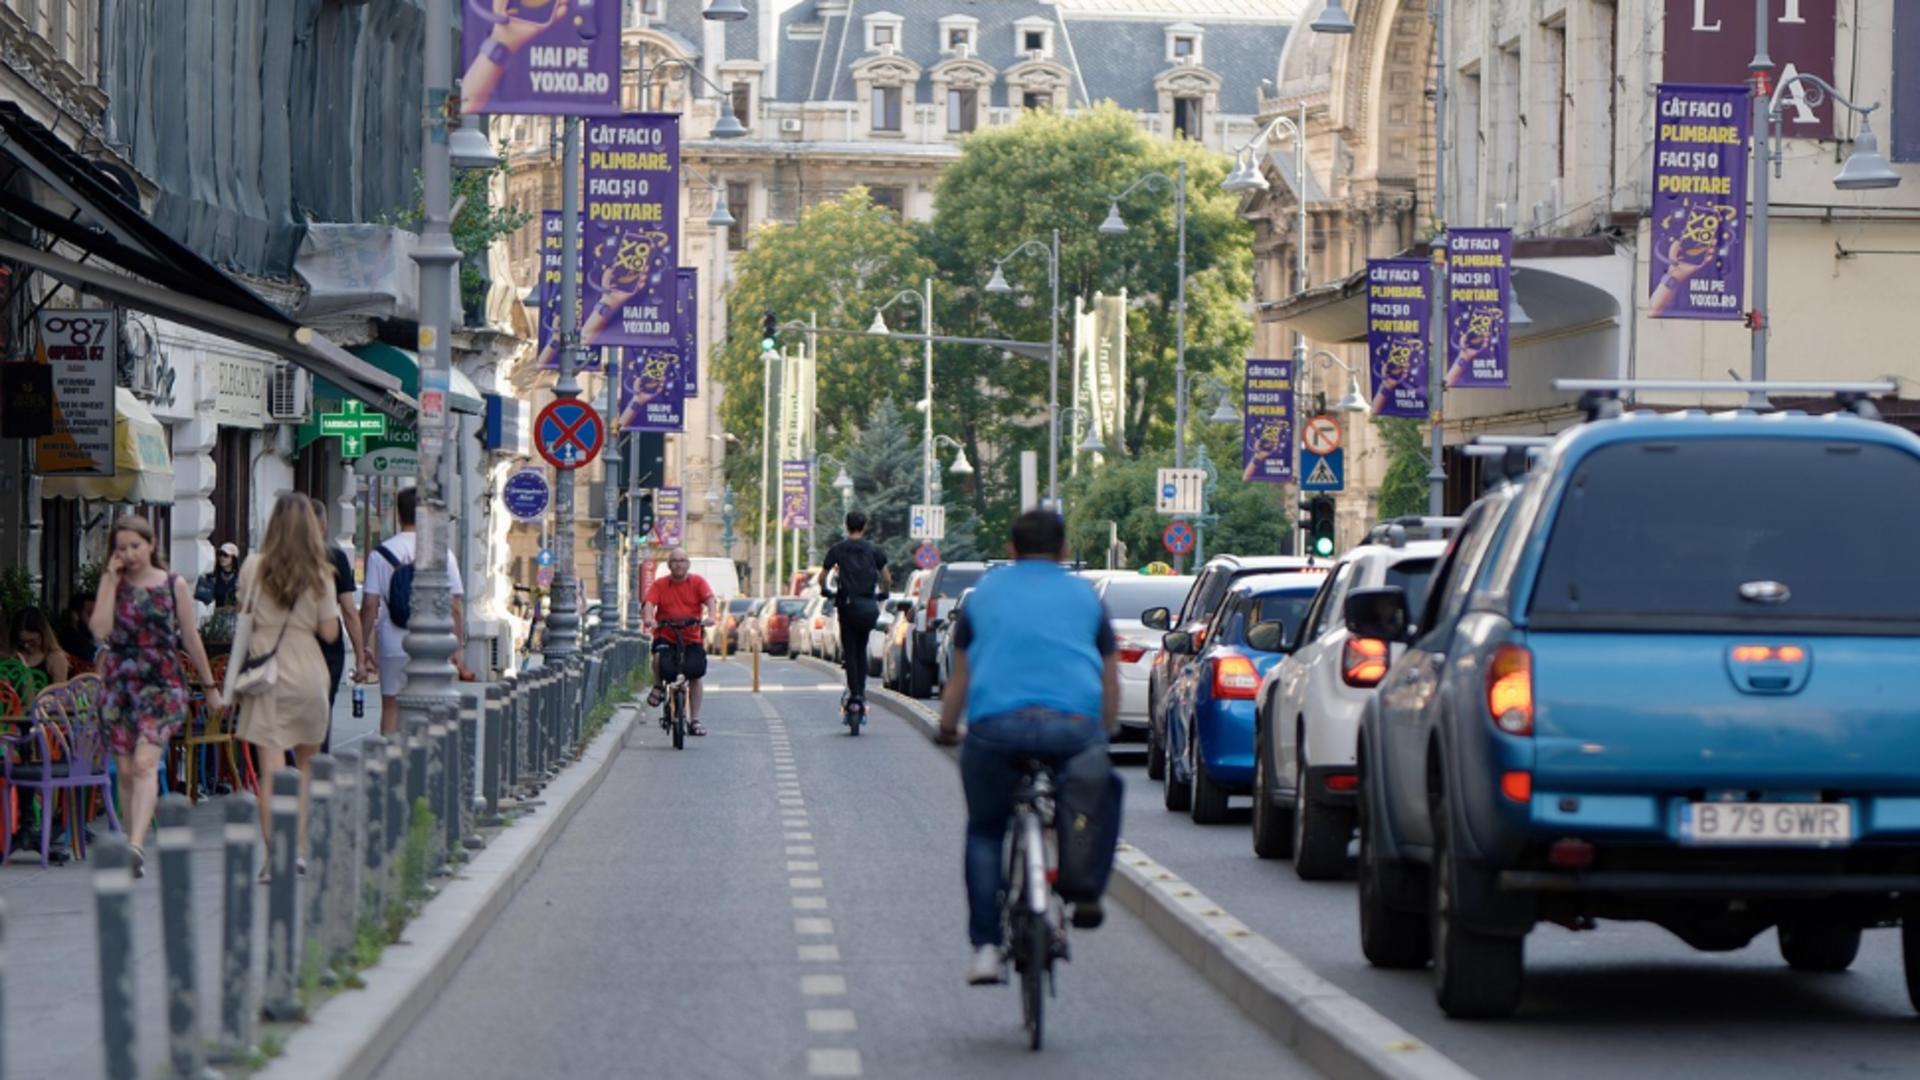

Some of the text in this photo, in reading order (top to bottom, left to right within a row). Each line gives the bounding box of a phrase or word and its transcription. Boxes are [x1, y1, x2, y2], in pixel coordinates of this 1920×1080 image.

[529, 47, 589, 68] HAI PE
[530, 72, 609, 93] YOXO.RO
[1769, 63, 1820, 123] A
[1662, 96, 1733, 118] CÂT FACI O
[590, 124, 662, 144] CÂT FACI O
[1661, 124, 1741, 146] PLIMBARE,
[590, 151, 672, 172] PLIMBARE,
[1660, 151, 1690, 167] FACI
[1708, 152, 1718, 169] O
[590, 179, 620, 195] FACI
[639, 179, 648, 195] O
[1658, 175, 1731, 194] PORTARE
[590, 203, 662, 220] PORTARE
[1452, 236, 1499, 250] CÂT FACI O
[1371, 267, 1419, 281] CÂT FACI O
[1452, 273, 1471, 284] FACI
[1484, 273, 1491, 284] O
[1690, 278, 1725, 292] HAI PE
[1452, 288, 1499, 301] PORTARE
[1690, 293, 1737, 308] YOXO.RO
[623, 306, 658, 319] HAI PE
[1371, 303, 1390, 315] FACI
[1403, 304, 1410, 315] O
[623, 321, 670, 334] YOXO.RO
[1371, 319, 1420, 333] PORTARE
[1700, 805, 1718, 833] B
[1730, 806, 1765, 834] 79
[1774, 806, 1840, 834] GWR
